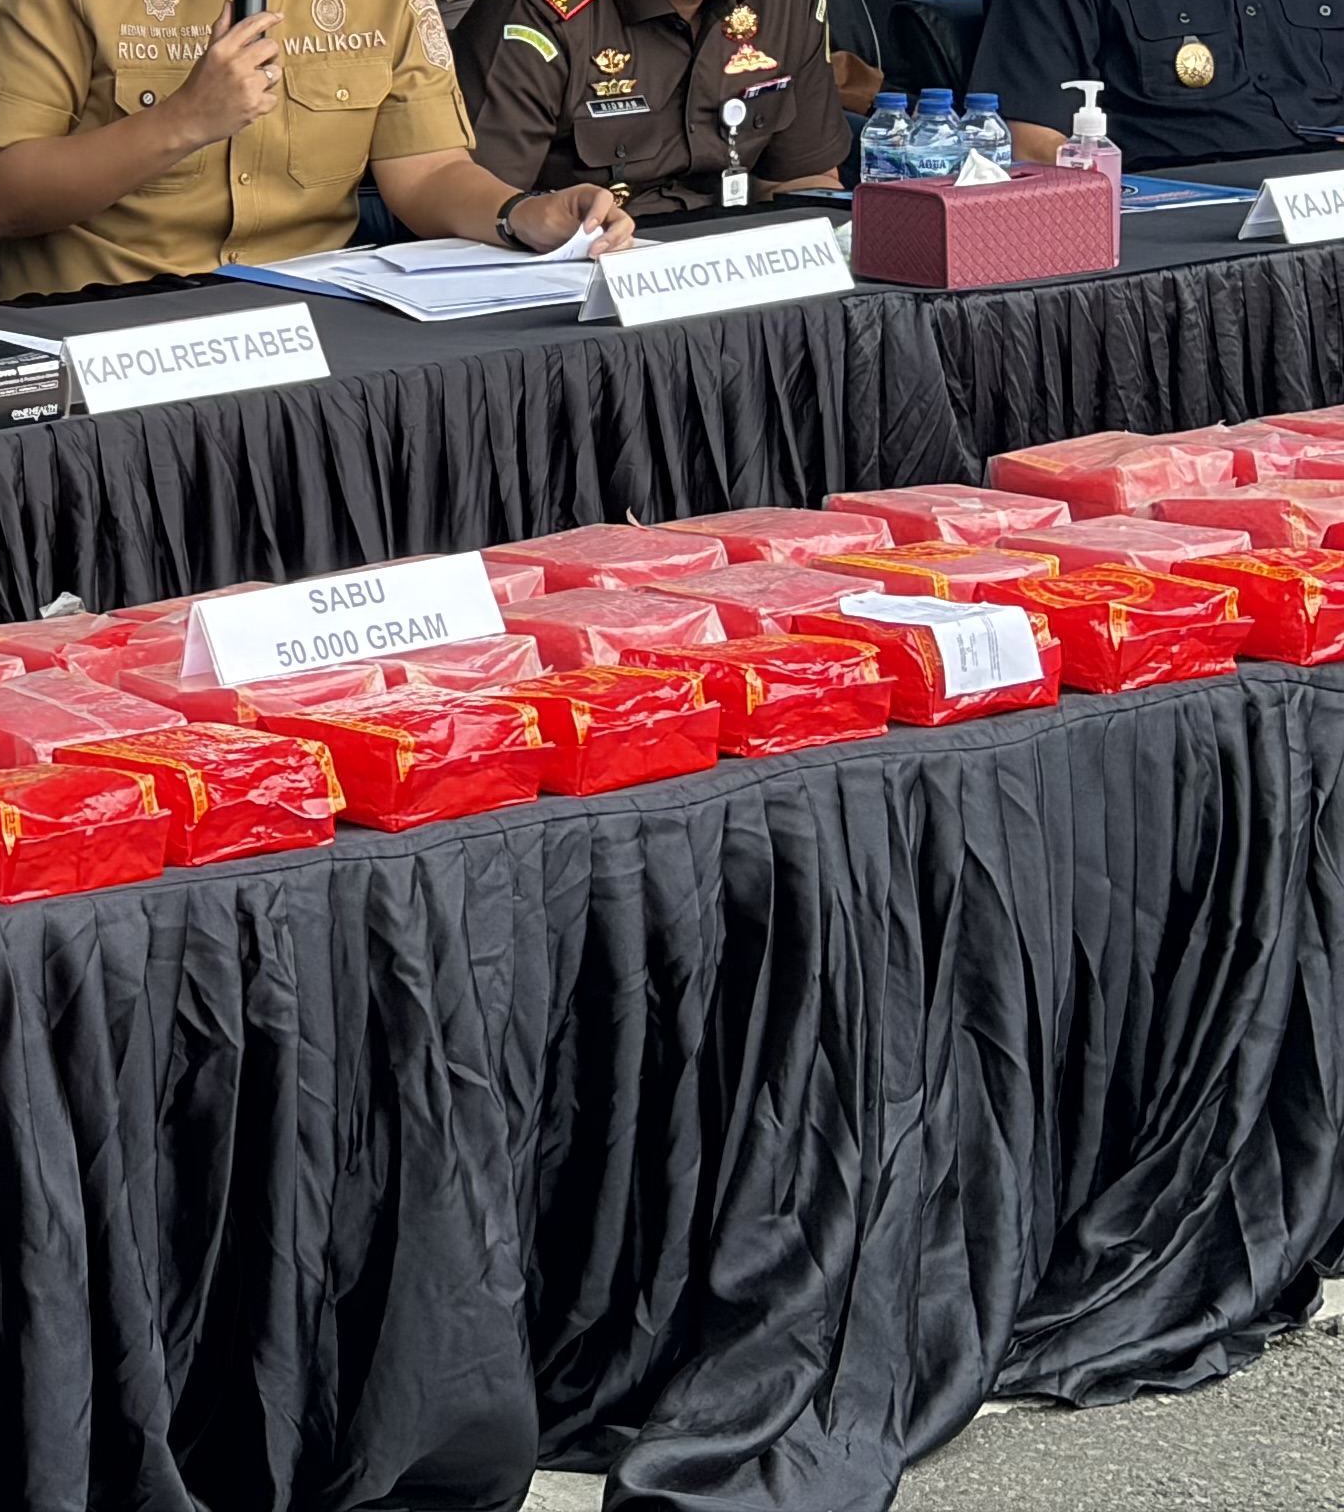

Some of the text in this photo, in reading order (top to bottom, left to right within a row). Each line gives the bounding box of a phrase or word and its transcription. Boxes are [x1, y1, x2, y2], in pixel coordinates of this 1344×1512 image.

[149, 23, 178, 38] UNTUK
[283, 29, 386, 56] WALIKOTA
[118, 41, 209, 61] RICO WAA
[917, 159, 947, 171] AQUA
[609, 242, 836, 299] WALIKOTA MEDAN
[77, 325, 314, 386] KAPOLRESTABES
[308, 577, 387, 615] SABU
[275, 612, 449, 668] 50.000 GRAM
